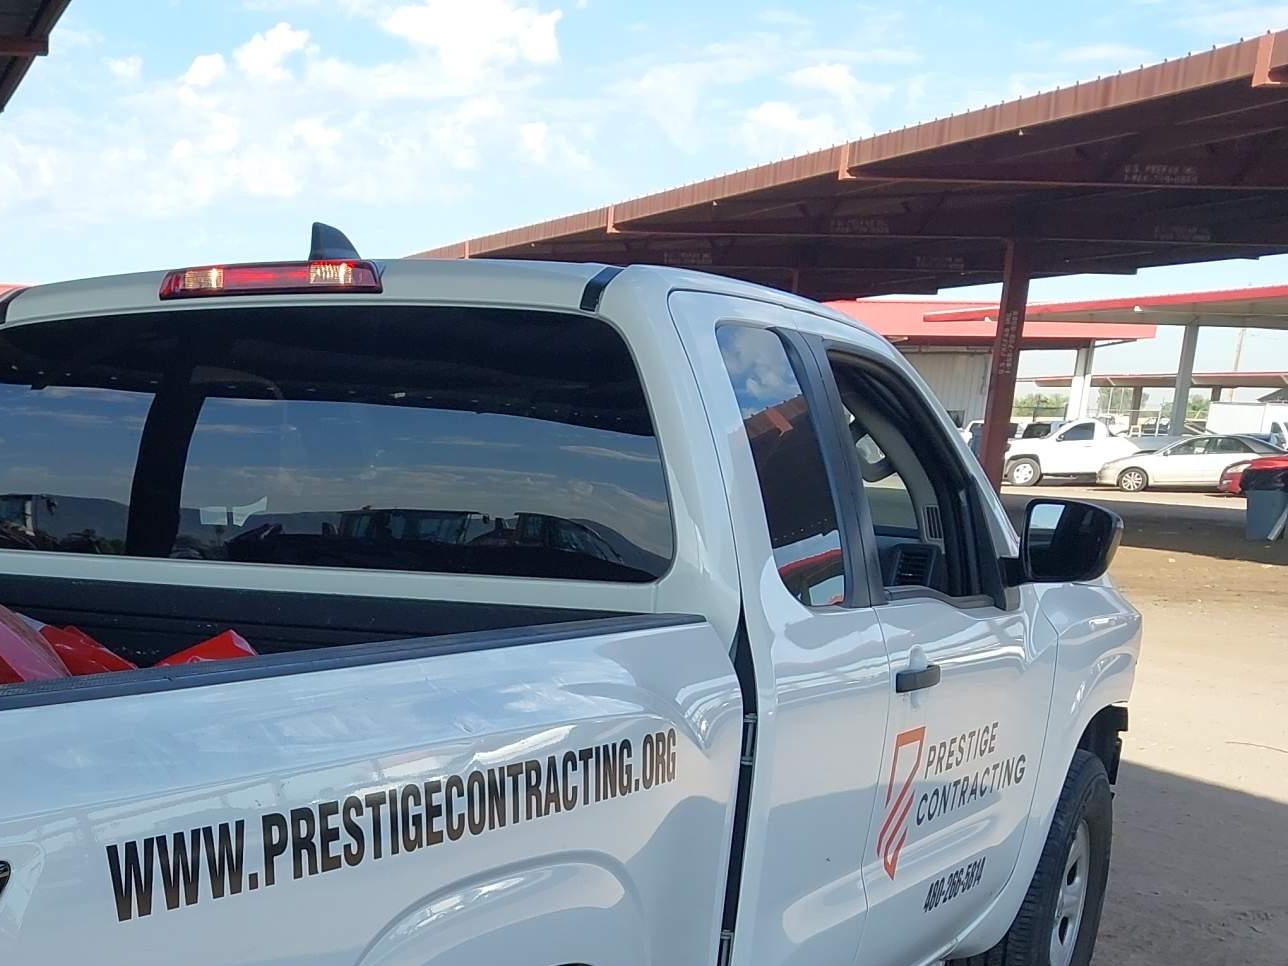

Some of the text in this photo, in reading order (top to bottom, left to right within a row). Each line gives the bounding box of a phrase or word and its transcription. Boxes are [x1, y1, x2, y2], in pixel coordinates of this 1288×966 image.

[924, 722, 999, 779] PRESTIGE
[105, 728, 678, 922] WWW.PRESTIGECONTRACTING.ORG
[916, 754, 1026, 826] CONTRACTING
